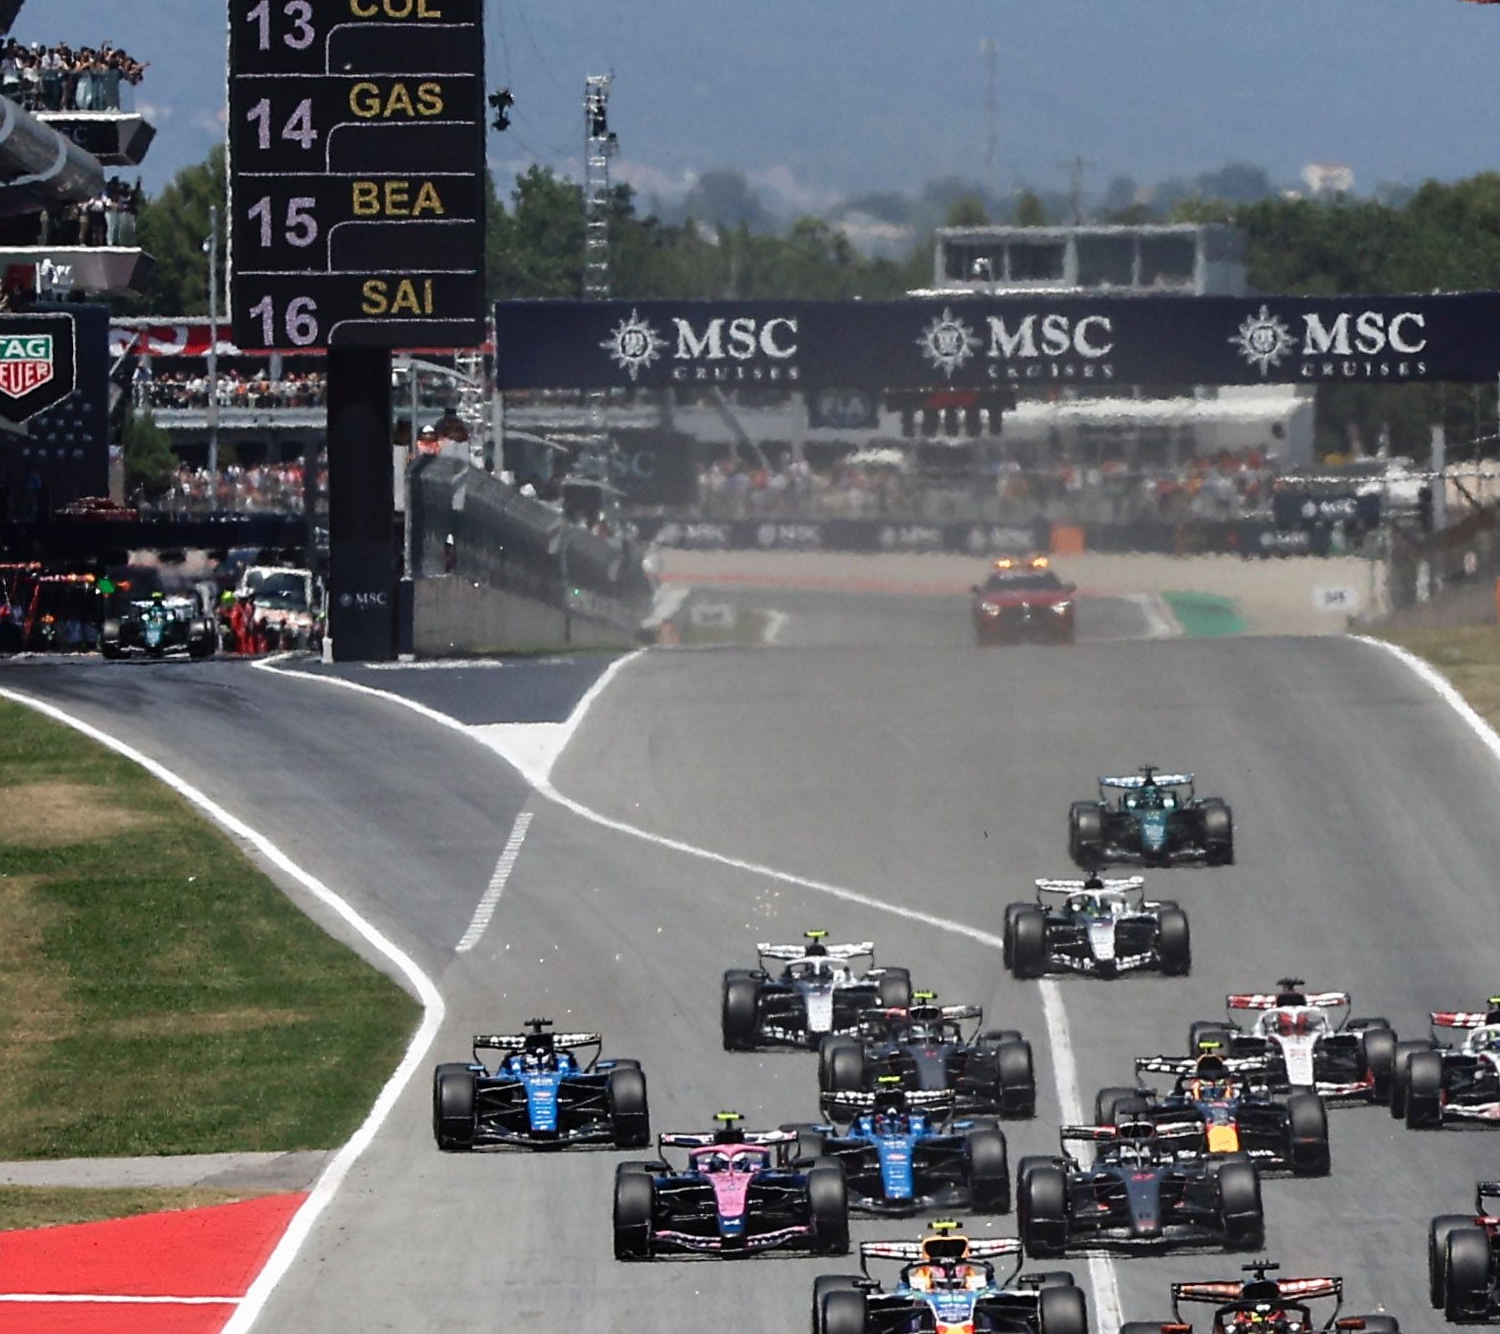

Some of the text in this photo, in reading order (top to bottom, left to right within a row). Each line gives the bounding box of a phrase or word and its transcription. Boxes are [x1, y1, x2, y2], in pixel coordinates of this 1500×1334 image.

[246, 0, 316, 51] 13
[246, 82, 445, 150] 14 GAS
[247, 181, 445, 248] 15 BEA
[249, 279, 434, 347] 16 SAI
[671, 317, 799, 360] MSC
[986, 314, 1115, 359] MSC
[1302, 310, 1428, 355] MSC
